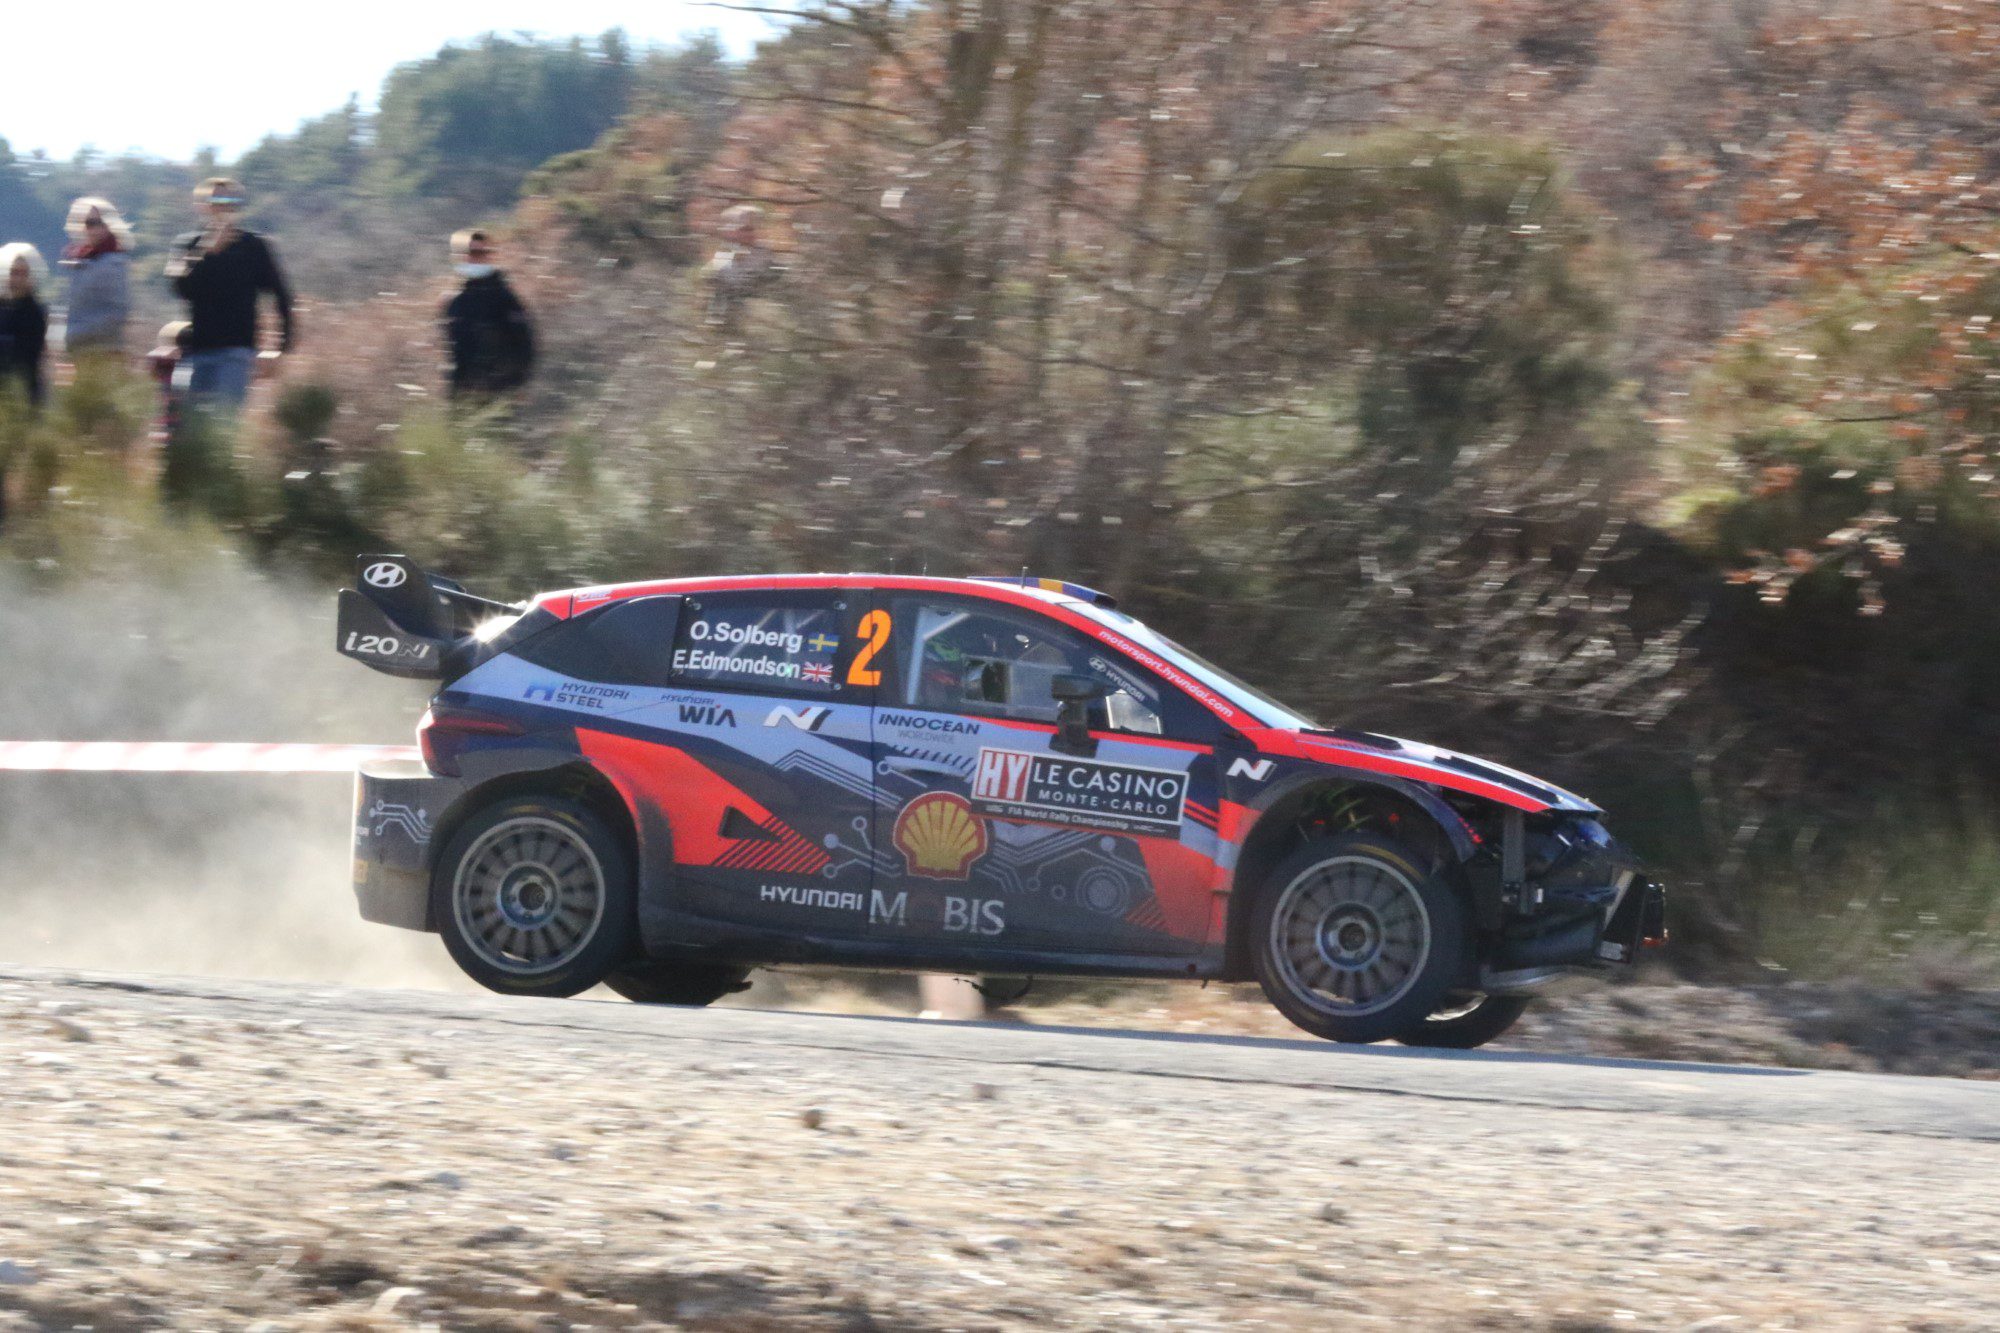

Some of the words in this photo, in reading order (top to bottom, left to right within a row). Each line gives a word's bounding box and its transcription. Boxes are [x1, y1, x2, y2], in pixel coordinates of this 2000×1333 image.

[344, 631, 399, 656] i20
[690, 620, 803, 654] O.Solberg
[847, 609, 892, 686] 2
[672, 649, 801, 679] E.Edmondson
[1099, 631, 1235, 718] motorsport.hyundai.com
[556, 692, 604, 709] STEEL
[561, 682, 630, 701] HYUNDAI
[879, 713, 982, 735] INNOCEAN
[977, 751, 1028, 800] HY
[1032, 762, 1062, 785] LE
[1067, 767, 1179, 799] CASINO
[760, 885, 863, 910] HYUNDAI
